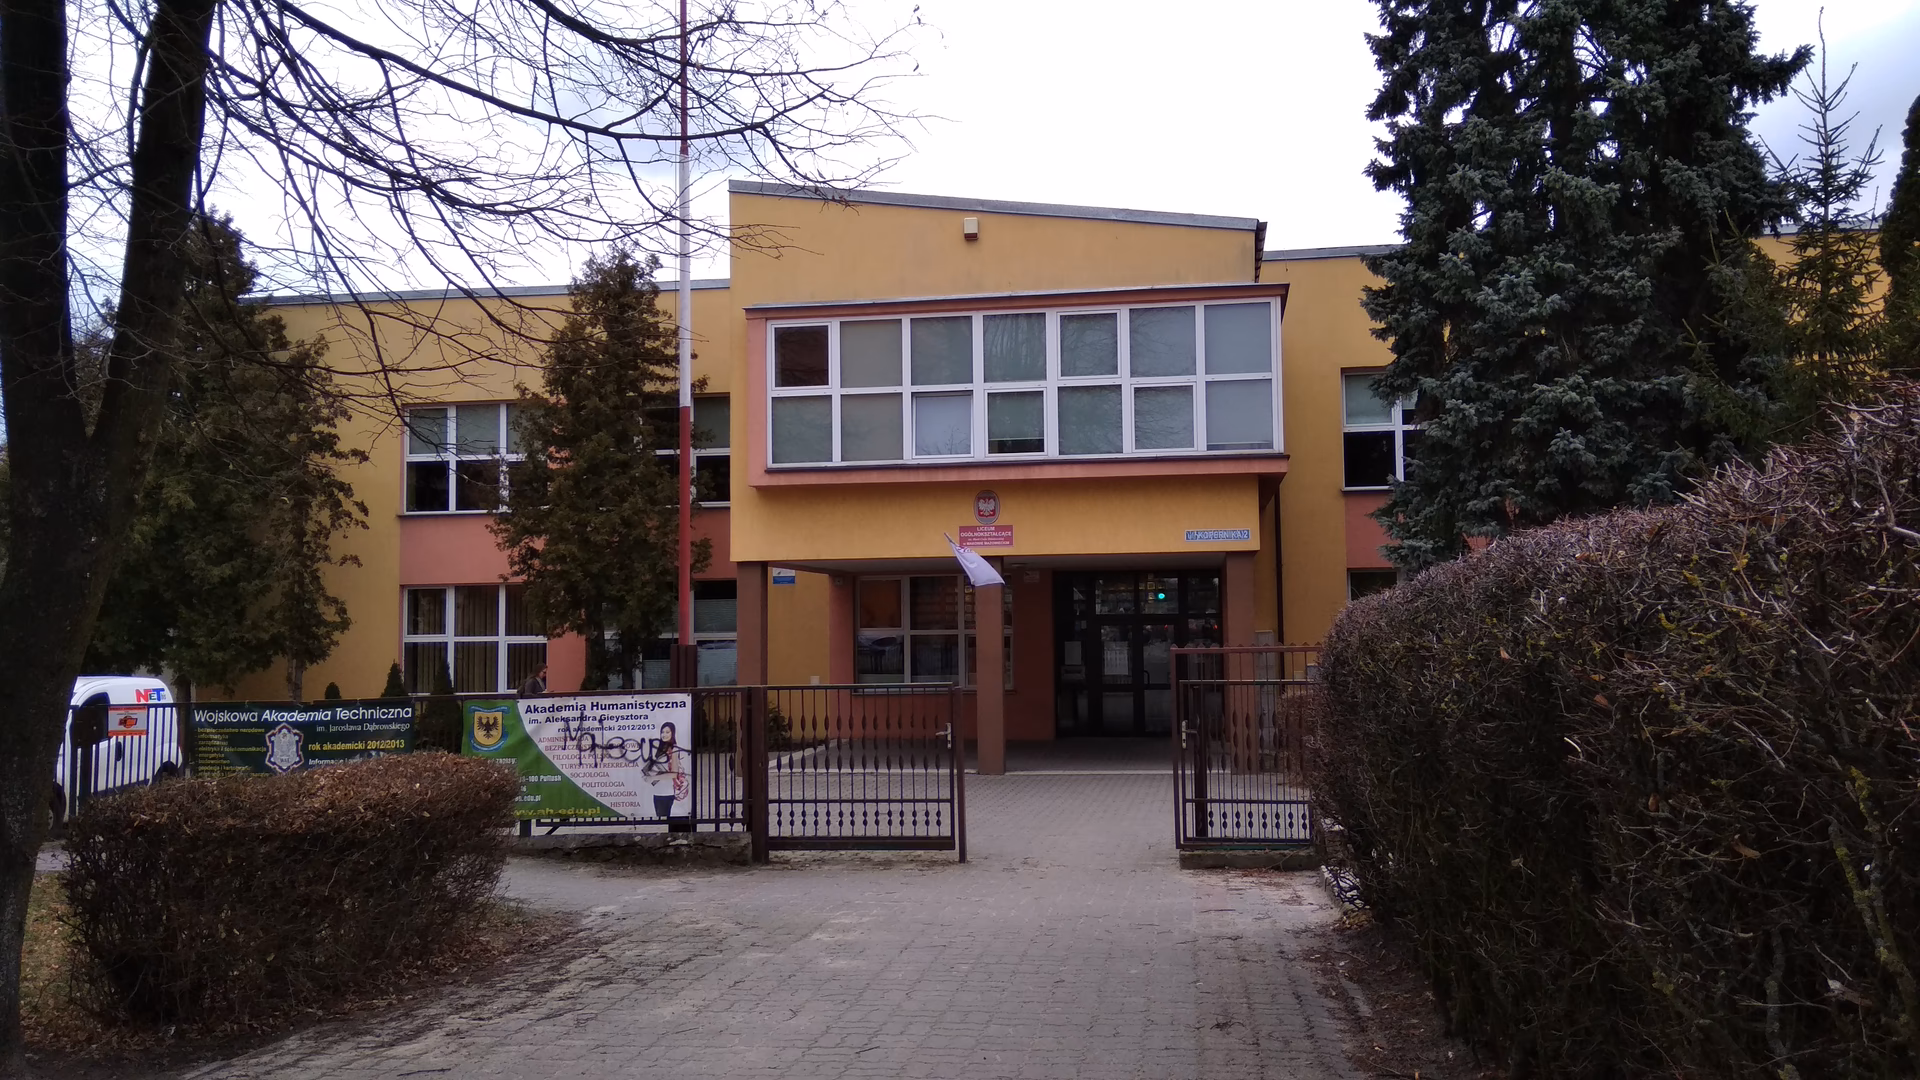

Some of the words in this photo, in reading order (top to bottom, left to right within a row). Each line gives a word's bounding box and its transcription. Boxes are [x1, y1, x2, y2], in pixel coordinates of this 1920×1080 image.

[525, 701, 587, 715] Akademia
[591, 700, 687, 712] Humanistyczna
[194, 709, 258, 724] Wojskowa
[261, 708, 331, 722] Akademia
[336, 706, 412, 720] Techniczna
[528, 717, 542, 725] im.
[545, 713, 597, 724] Aleksandra
[600, 713, 649, 723] Gieysztora
[316, 724, 328, 732] im.
[329, 723, 361, 732] Jarosława
[363, 721, 410, 732] Dąbrowskiego
[617, 724, 657, 732] 2012/2013
[309, 742, 321, 751] rok
[322, 741, 365, 751] akademicki
[367, 739, 405, 749] 2012/2013
[602, 760, 640, 769] REKREACJA
[570, 771, 610, 779] SOCJOLOGIA
[610, 800, 642, 808] HISTORIA
